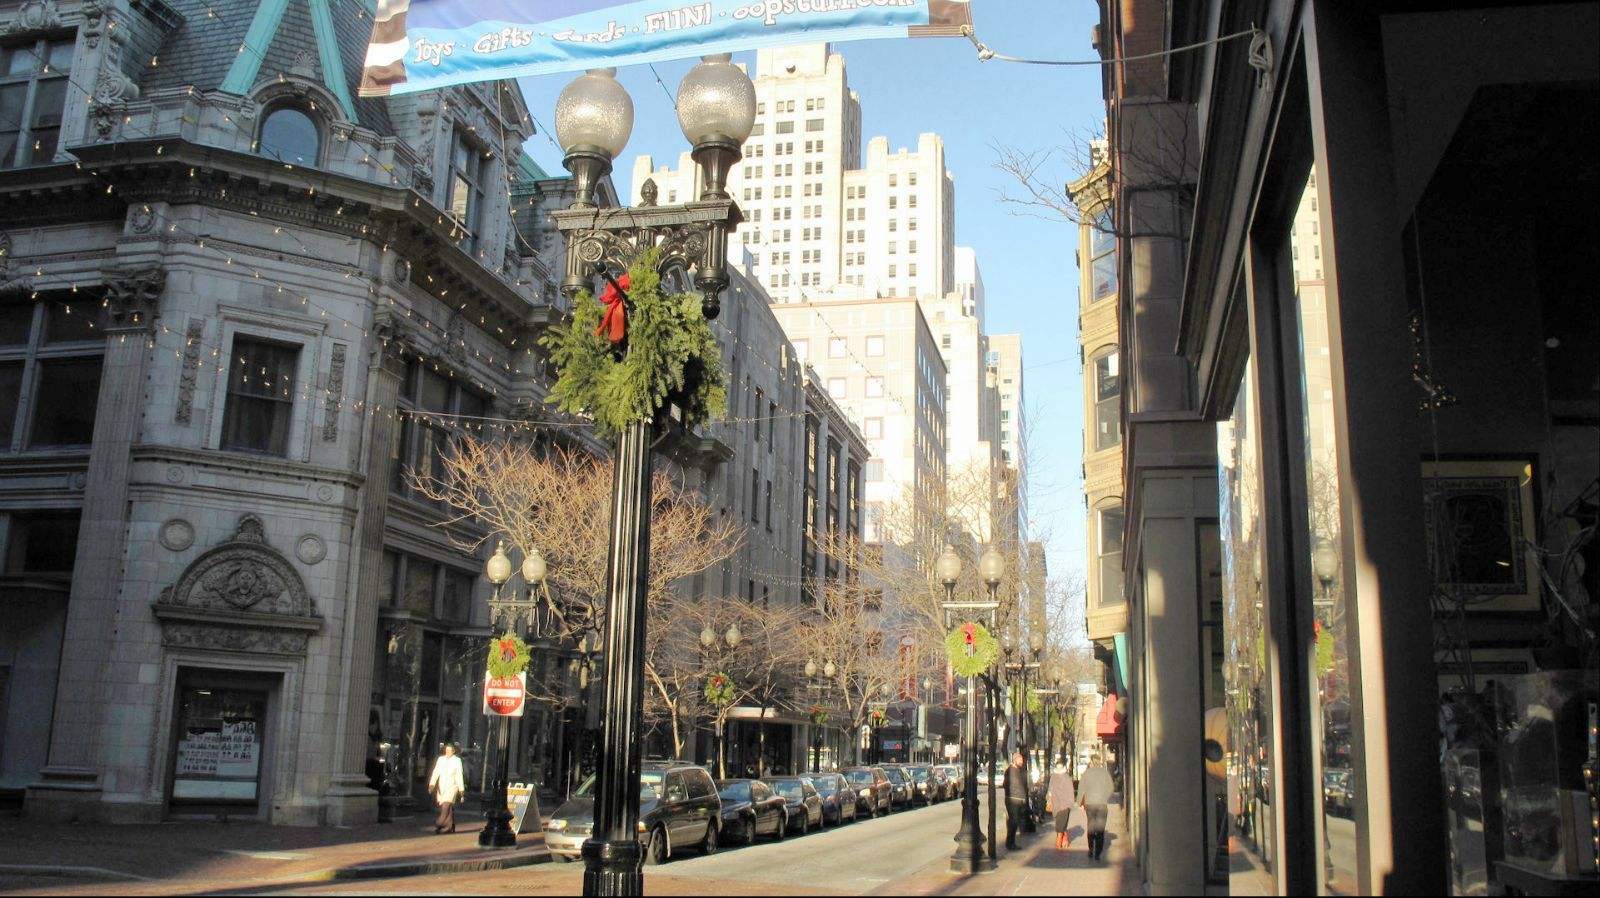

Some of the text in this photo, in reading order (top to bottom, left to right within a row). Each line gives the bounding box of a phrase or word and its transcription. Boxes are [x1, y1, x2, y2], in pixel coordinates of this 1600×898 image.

[413, 37, 456, 66] Toys
[472, 27, 533, 54] Gifts
[644, 2, 712, 35] FUN!
[504, 680, 519, 688] NOT
[492, 698, 515, 707] ENTER
